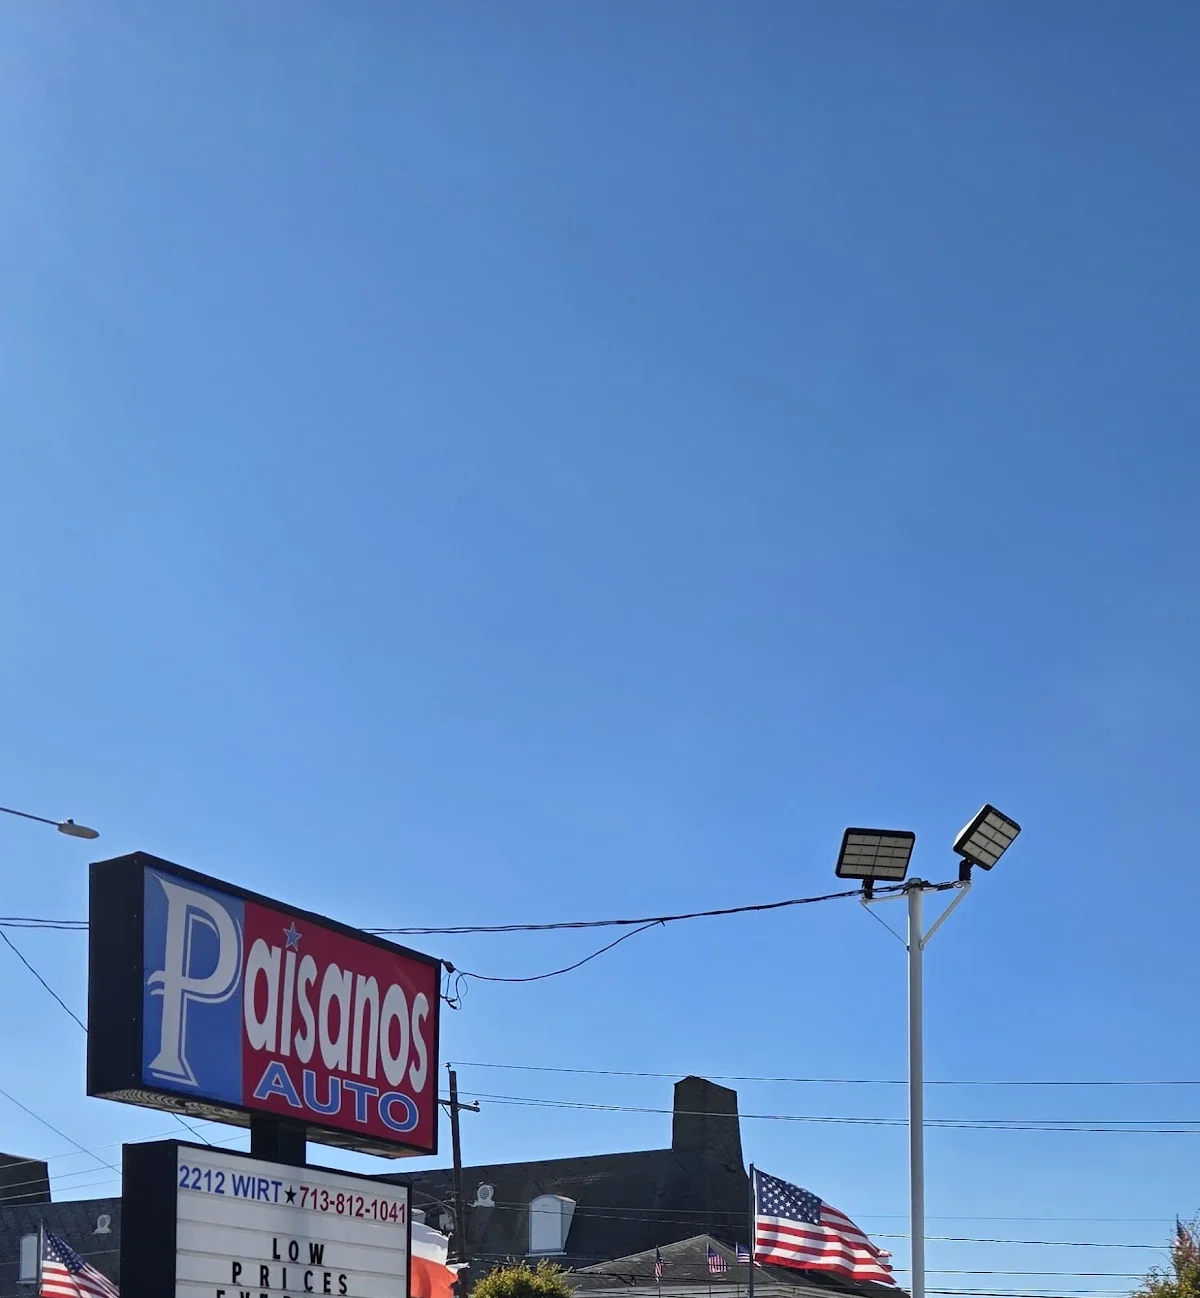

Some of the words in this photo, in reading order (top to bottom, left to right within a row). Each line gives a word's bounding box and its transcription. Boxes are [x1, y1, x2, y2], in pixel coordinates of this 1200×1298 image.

[145, 872, 430, 1094] Paisanos
[253, 1061, 419, 1133] AUTO
[179, 1165, 225, 1194] 2212
[232, 1173, 283, 1203] WIRT
[300, 1186, 406, 1224] 713-812-1041
[232, 1261, 348, 1296] PRICES
[272, 1237, 324, 1266] LOW
